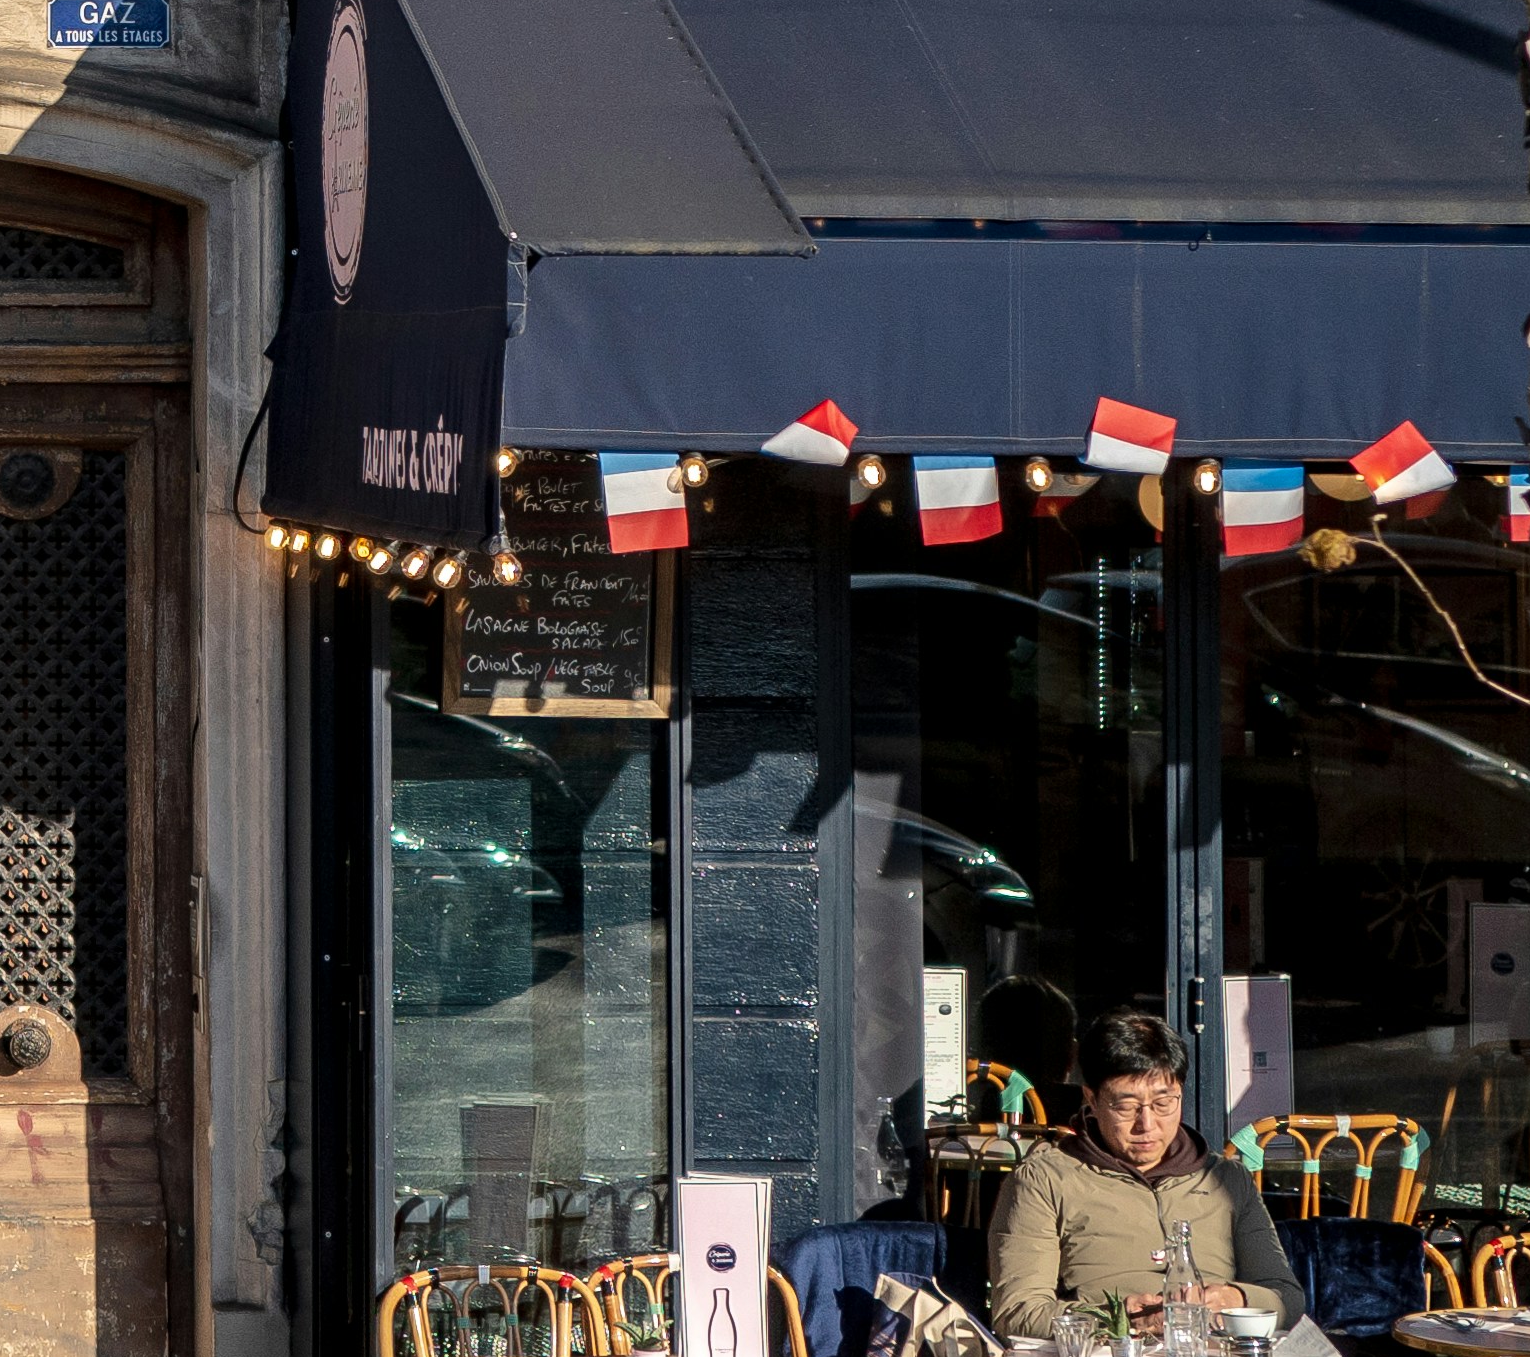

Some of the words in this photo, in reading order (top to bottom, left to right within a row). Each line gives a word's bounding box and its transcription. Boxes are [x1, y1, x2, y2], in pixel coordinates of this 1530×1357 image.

[79, 2, 135, 25] GAZ
[55, 30, 63, 43] A
[65, 29, 94, 43] TOUS
[98, 29, 118, 43] LES
[122, 27, 163, 43] ÉTAGES
